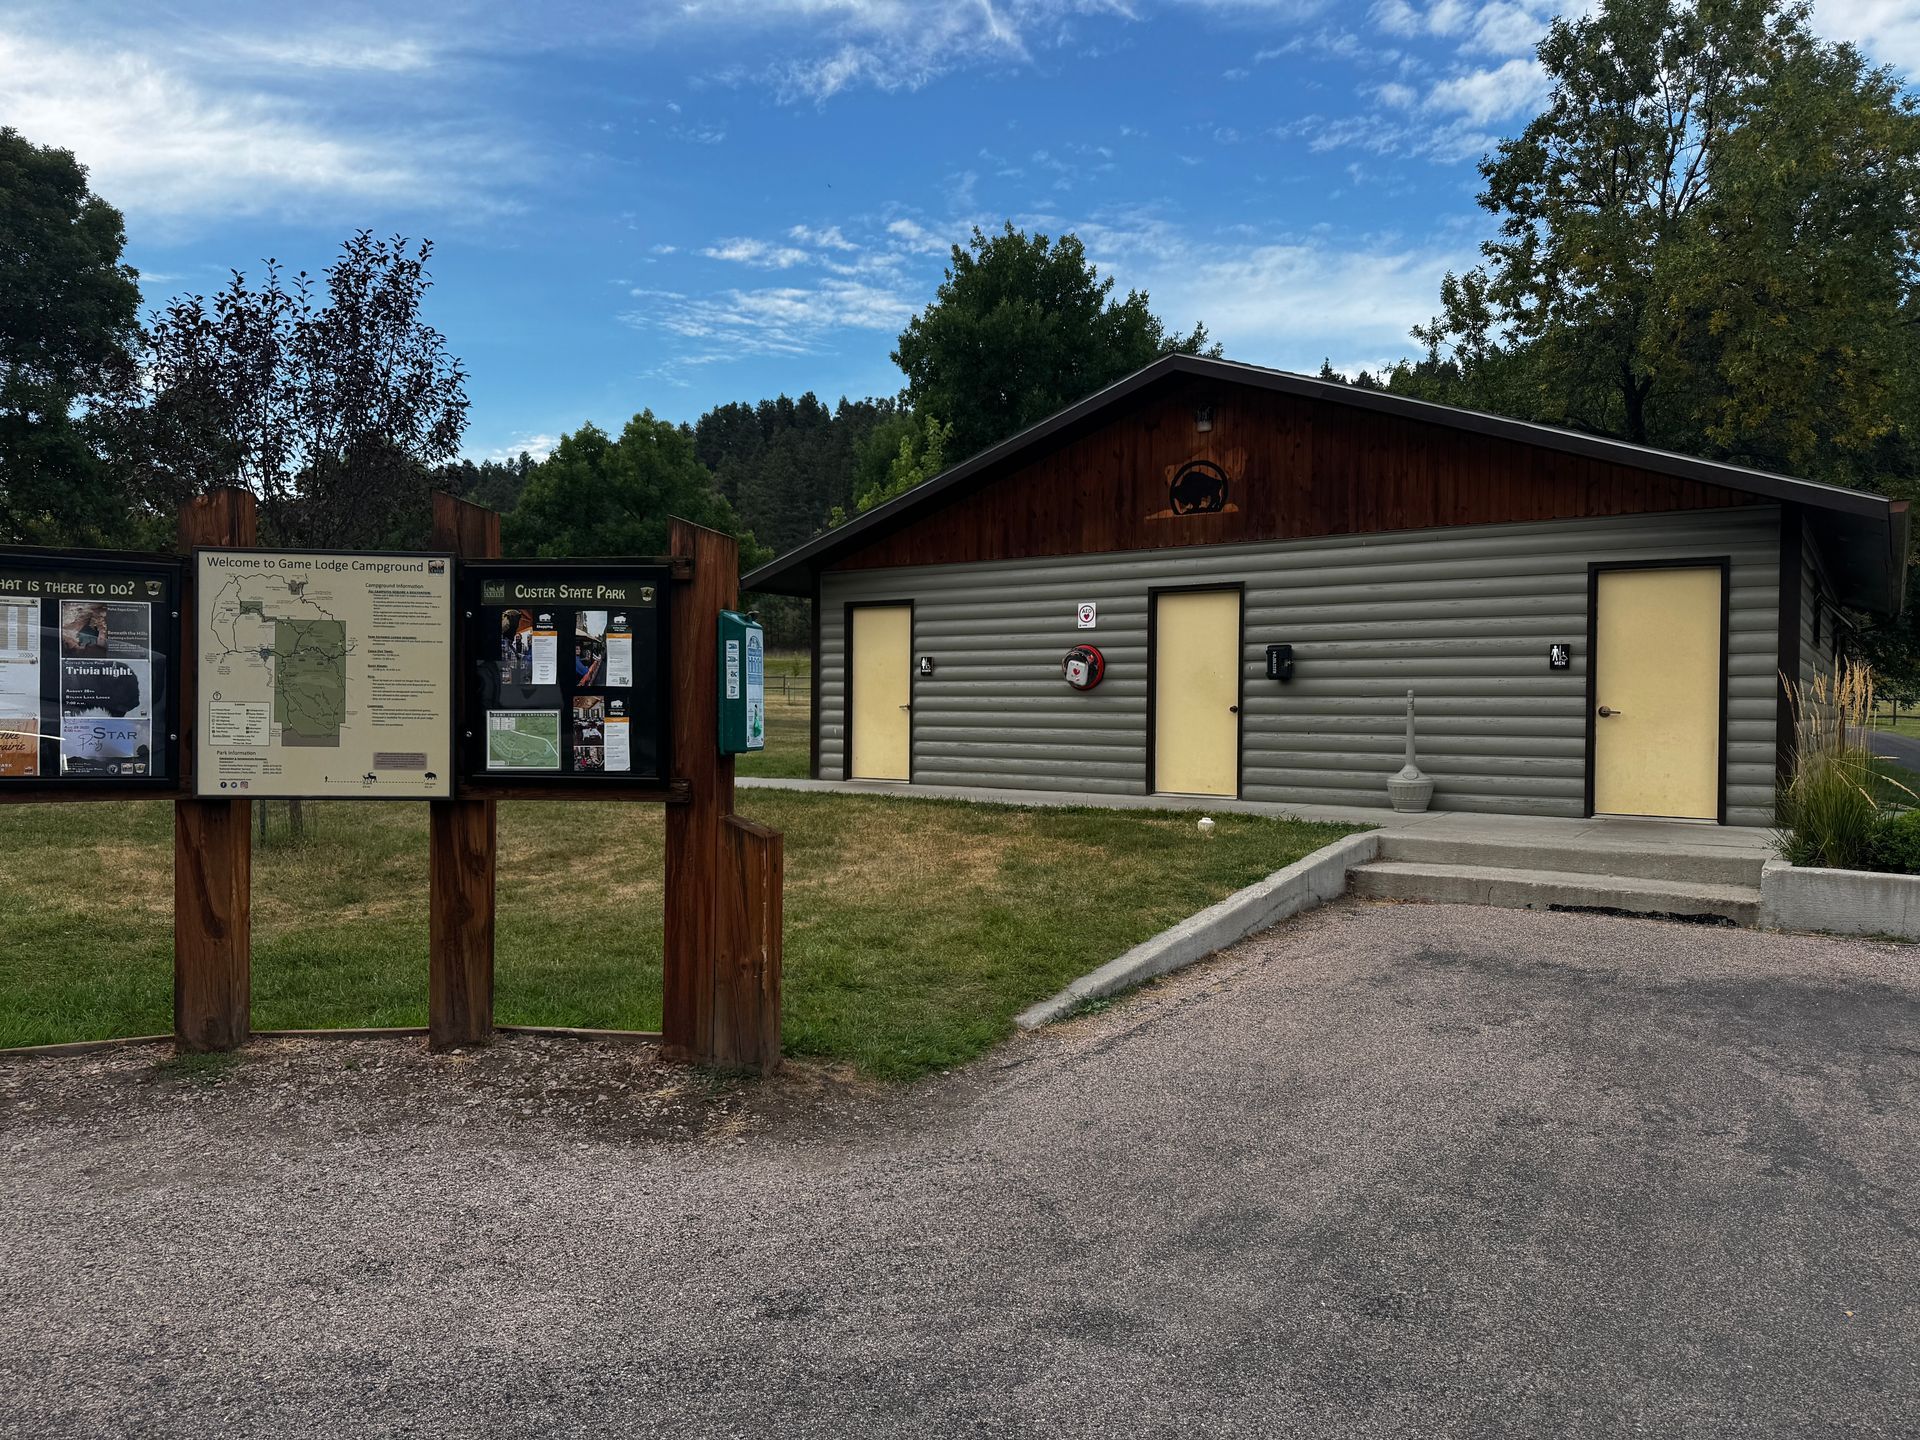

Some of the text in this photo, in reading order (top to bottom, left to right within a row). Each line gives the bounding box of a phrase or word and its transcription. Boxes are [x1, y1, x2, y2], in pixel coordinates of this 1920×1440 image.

[207, 556, 424, 574] Welcome to Game Lodge Campground
[27, 580, 40, 592] IS
[44, 581, 84, 594] THERE
[88, 583, 106, 595] TO
[110, 581, 136, 596] DO?
[515, 584, 556, 599] CUSTER
[559, 584, 593, 599] STATE
[596, 585, 626, 600] PARK
[65, 666, 133, 678] Trivia Night
[93, 727, 137, 740] STAR
